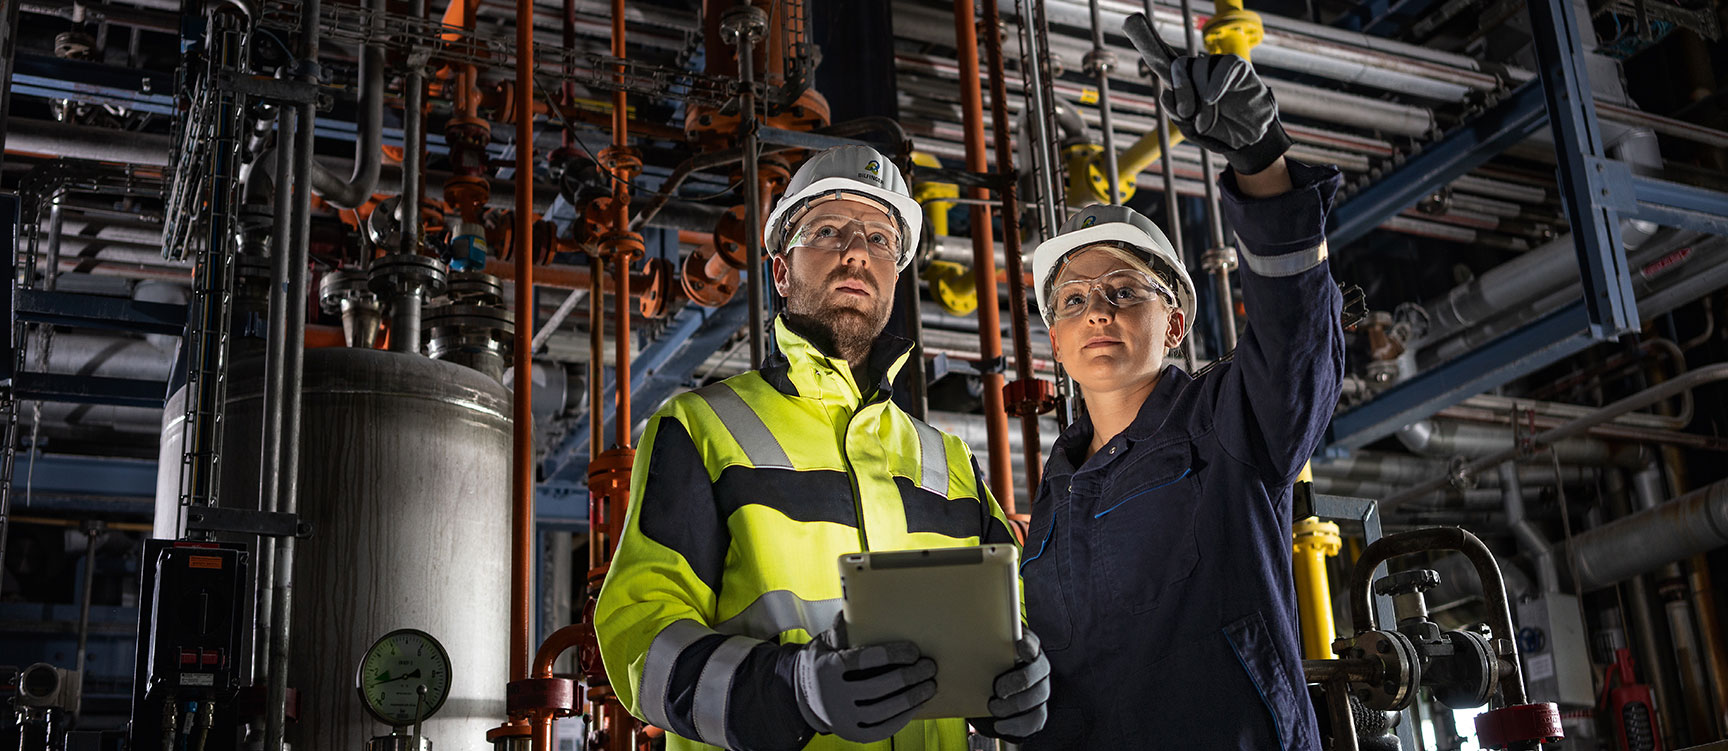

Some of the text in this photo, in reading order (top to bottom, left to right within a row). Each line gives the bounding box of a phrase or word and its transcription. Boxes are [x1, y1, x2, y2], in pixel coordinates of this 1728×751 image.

[390, 647, 395, 655] 4
[418, 648, 422, 656] 6
[374, 667, 378, 676] 2
[381, 691, 385, 700] 0
